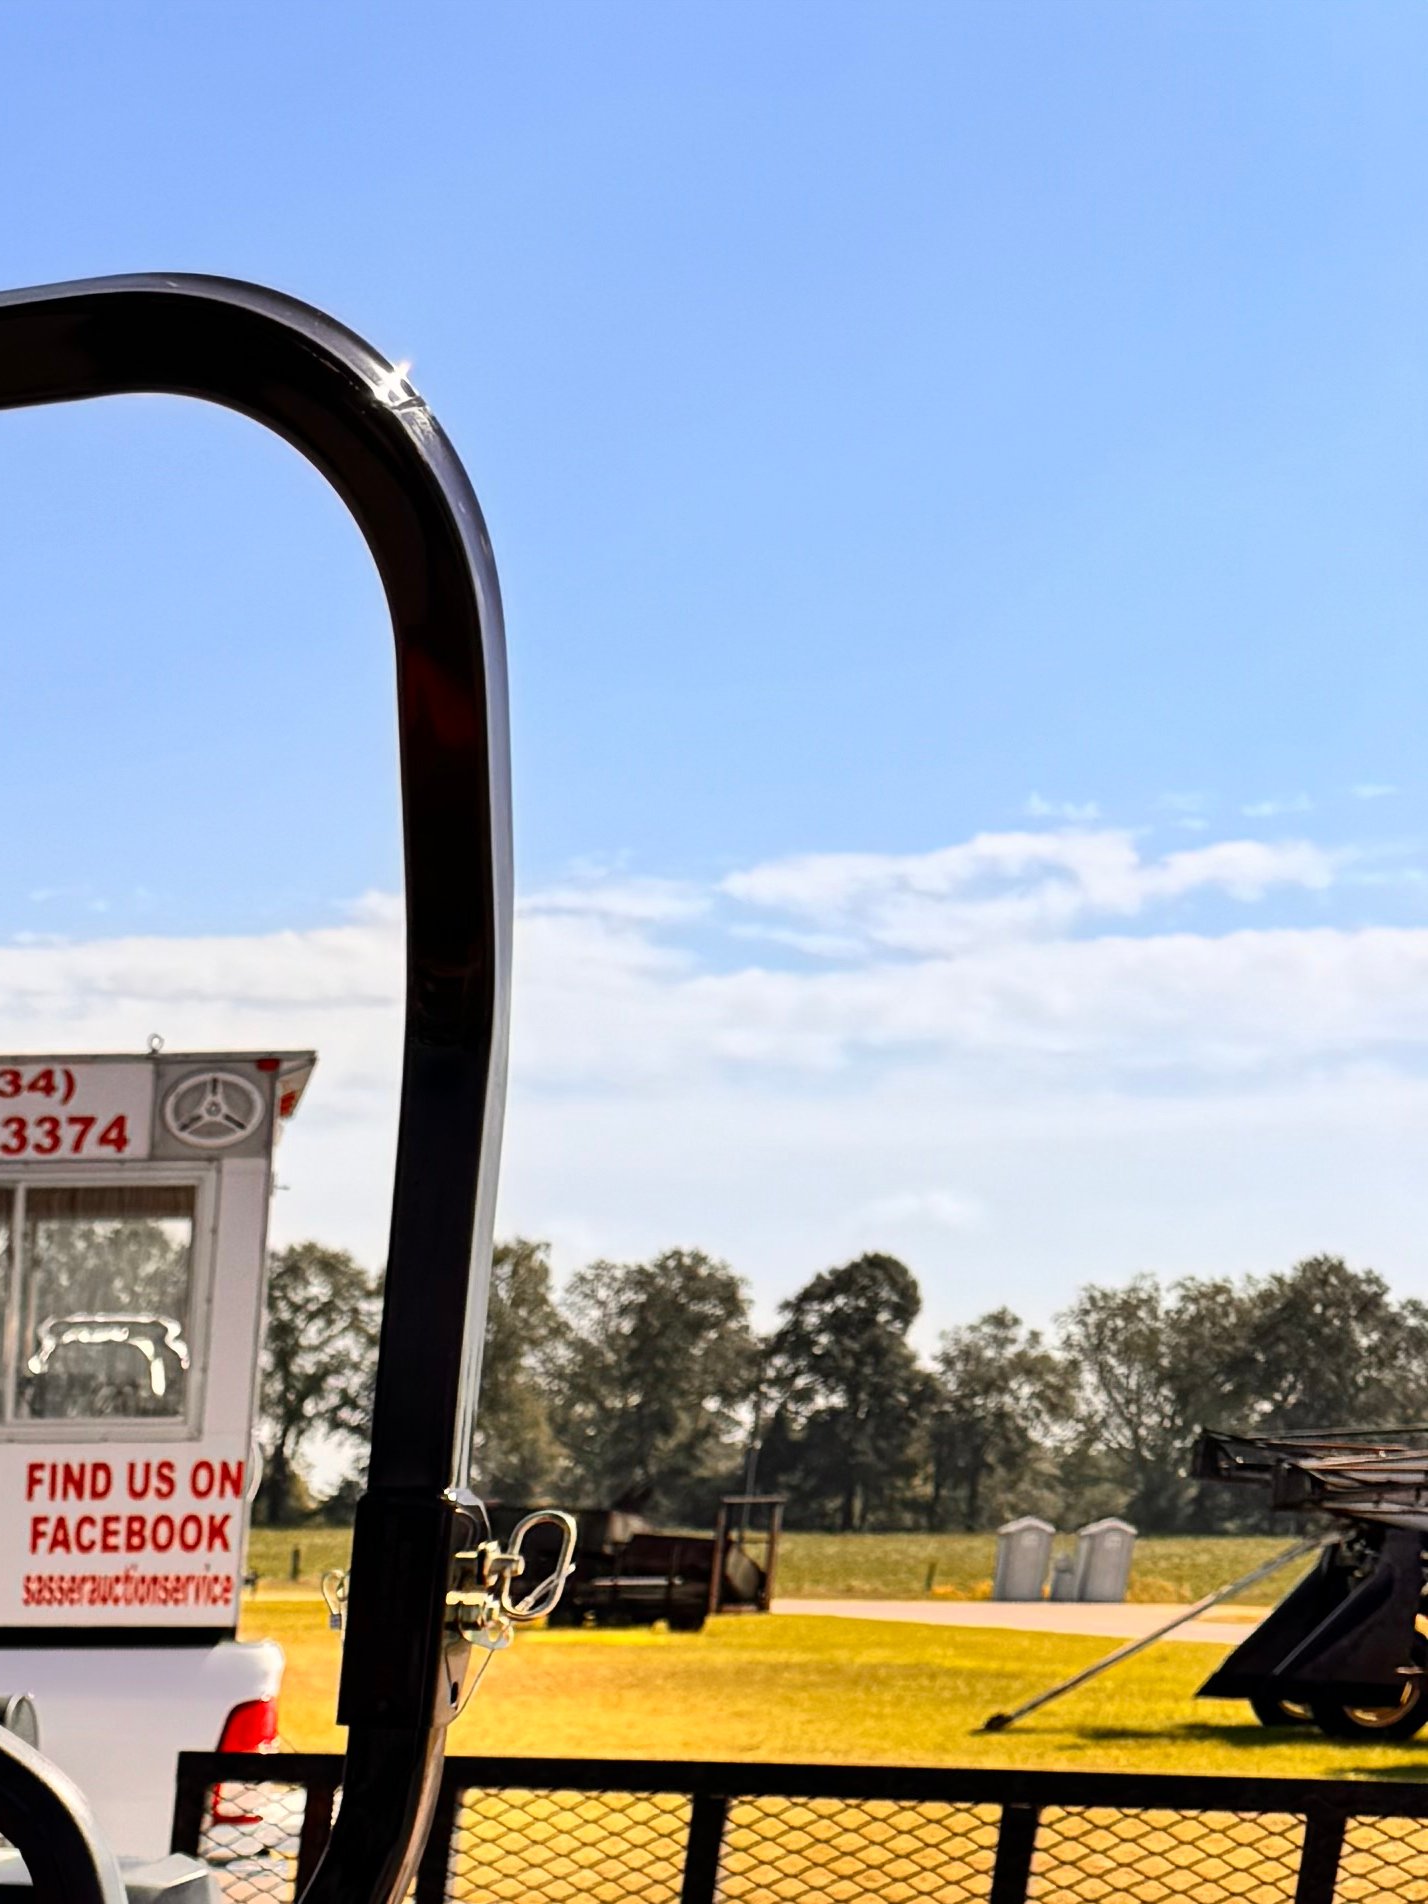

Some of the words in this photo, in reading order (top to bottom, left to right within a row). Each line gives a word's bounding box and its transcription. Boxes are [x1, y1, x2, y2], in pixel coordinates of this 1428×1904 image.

[26, 1462, 112, 1501] FIND
[127, 1460, 176, 1500] US
[191, 1460, 244, 1499] ON
[30, 1514, 231, 1554] FACEBOOK
